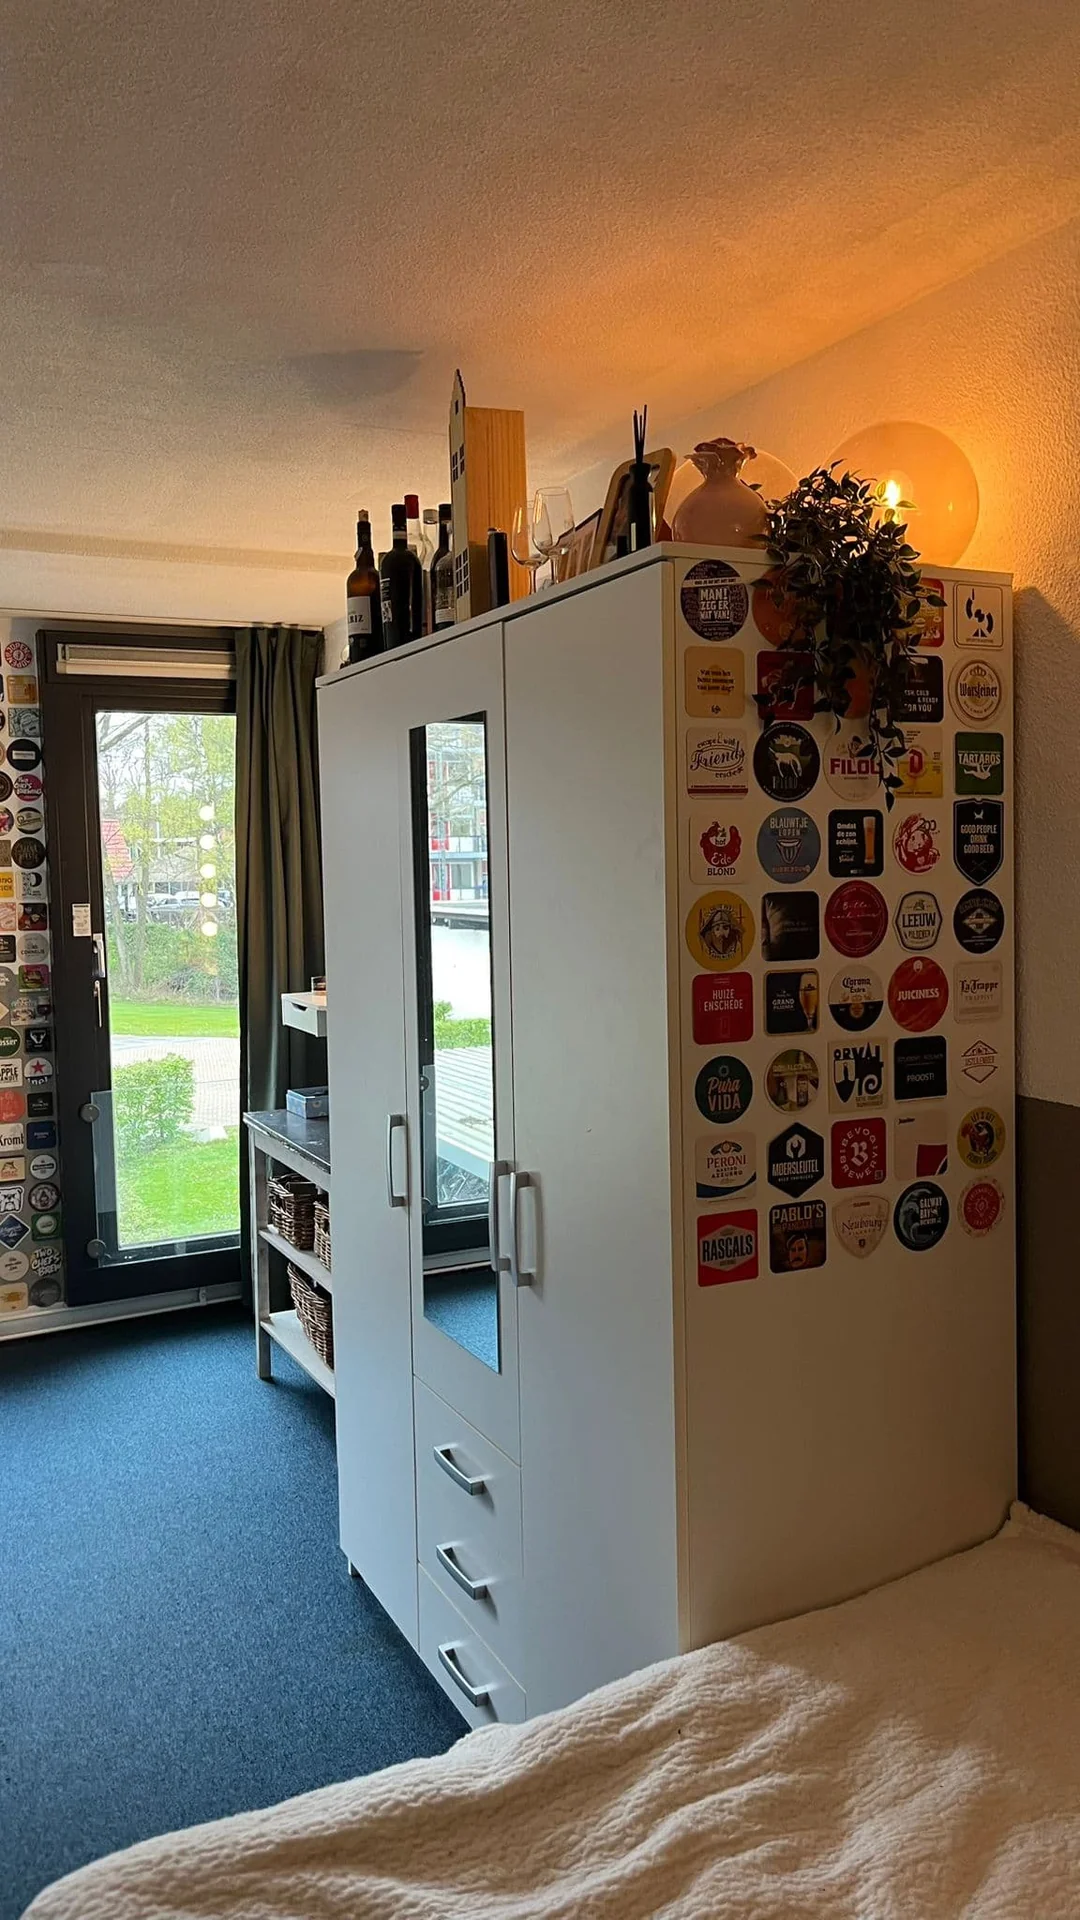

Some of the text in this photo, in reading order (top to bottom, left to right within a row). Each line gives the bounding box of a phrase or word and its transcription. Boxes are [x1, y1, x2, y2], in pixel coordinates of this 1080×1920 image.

[700, 588, 728, 601] MAN!
[700, 600, 729, 611] ZEG ER
[700, 609, 730, 620] WAT VAN!
[959, 682, 997, 698] Warsteiner
[918, 703, 932, 713] YOU
[690, 741, 746, 771] Friends
[957, 752, 1001, 765] TARTAROS
[770, 817, 809, 829] BLAUWTJE
[836, 822, 857, 830] Omdat
[960, 824, 996, 834] GOOD PEOPLE
[836, 830, 844, 838] de
[969, 835, 986, 844] DRINK
[963, 844, 992, 854] GOOD BEER
[707, 867, 736, 876] BLOND
[902, 913, 936, 928] LEEUW
[842, 977, 872, 988] Corona
[960, 978, 998, 993] La Trappe
[712, 989, 735, 1000] HUIZE
[897, 988, 940, 1002] JUICINESS
[703, 999, 744, 1012] ENSCHEDE
[772, 998, 796, 1006] GRAND
[707, 1076, 743, 1095] Pura
[707, 1093, 742, 1112] VIDA
[707, 1154, 747, 1169] PERONI
[772, 1159, 819, 1177] MOERSLEUTEL
[711, 1170, 742, 1179] AZZURRO
[919, 1196, 943, 1209] GALWAY
[772, 1203, 824, 1225] PABLO'S
[919, 1208, 931, 1220] BAY
[34, 1247, 53, 1259] TWO
[702, 1234, 755, 1263] RASCALS
[31, 1251, 61, 1271] CHEFS
